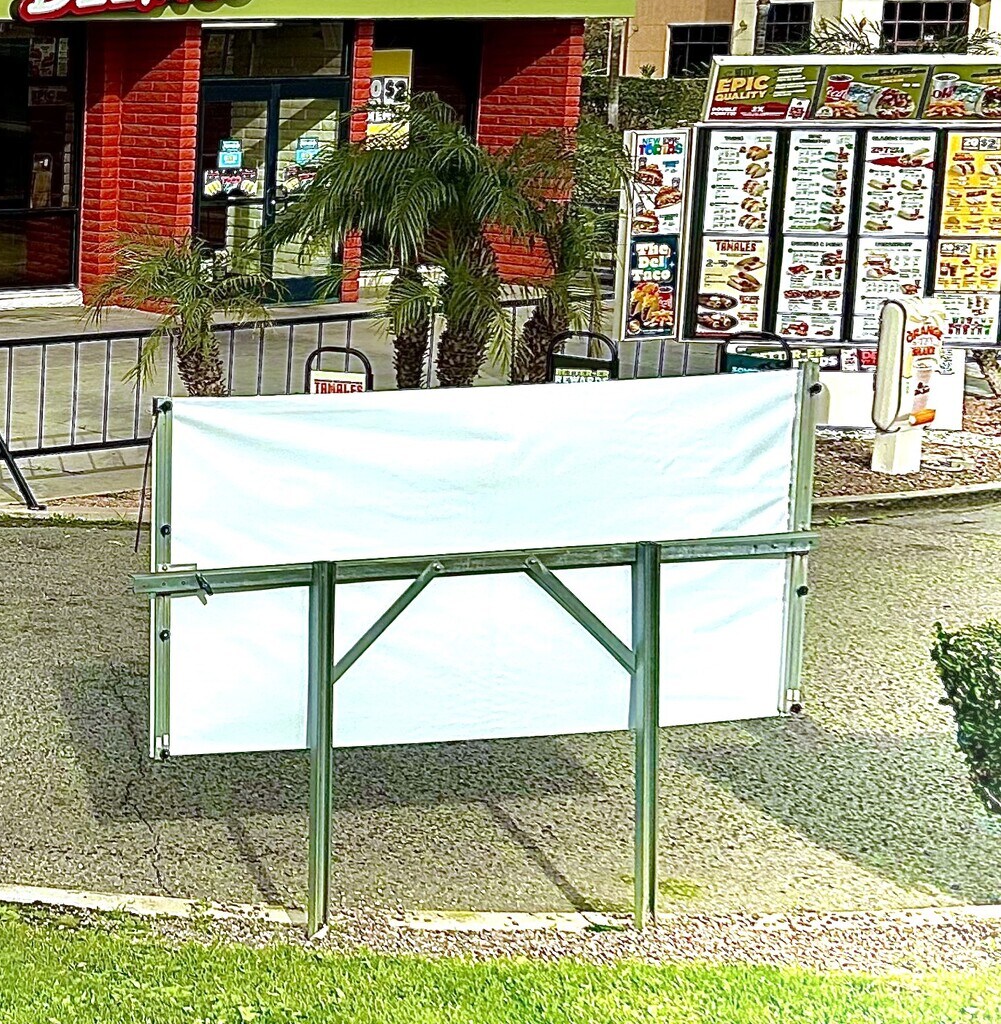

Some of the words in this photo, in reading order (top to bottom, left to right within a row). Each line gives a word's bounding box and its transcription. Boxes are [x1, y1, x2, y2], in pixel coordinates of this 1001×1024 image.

[370, 79, 382, 97] 0
[716, 75, 771, 94] EPIC
[714, 90, 768, 102] QUALITY
[962, 137, 979, 147] 20
[636, 242, 670, 256] The
[716, 242, 757, 252] TAMALES
[638, 256, 666, 268] Del
[631, 269, 671, 282] Taco
[314, 382, 364, 394] TAMALES
